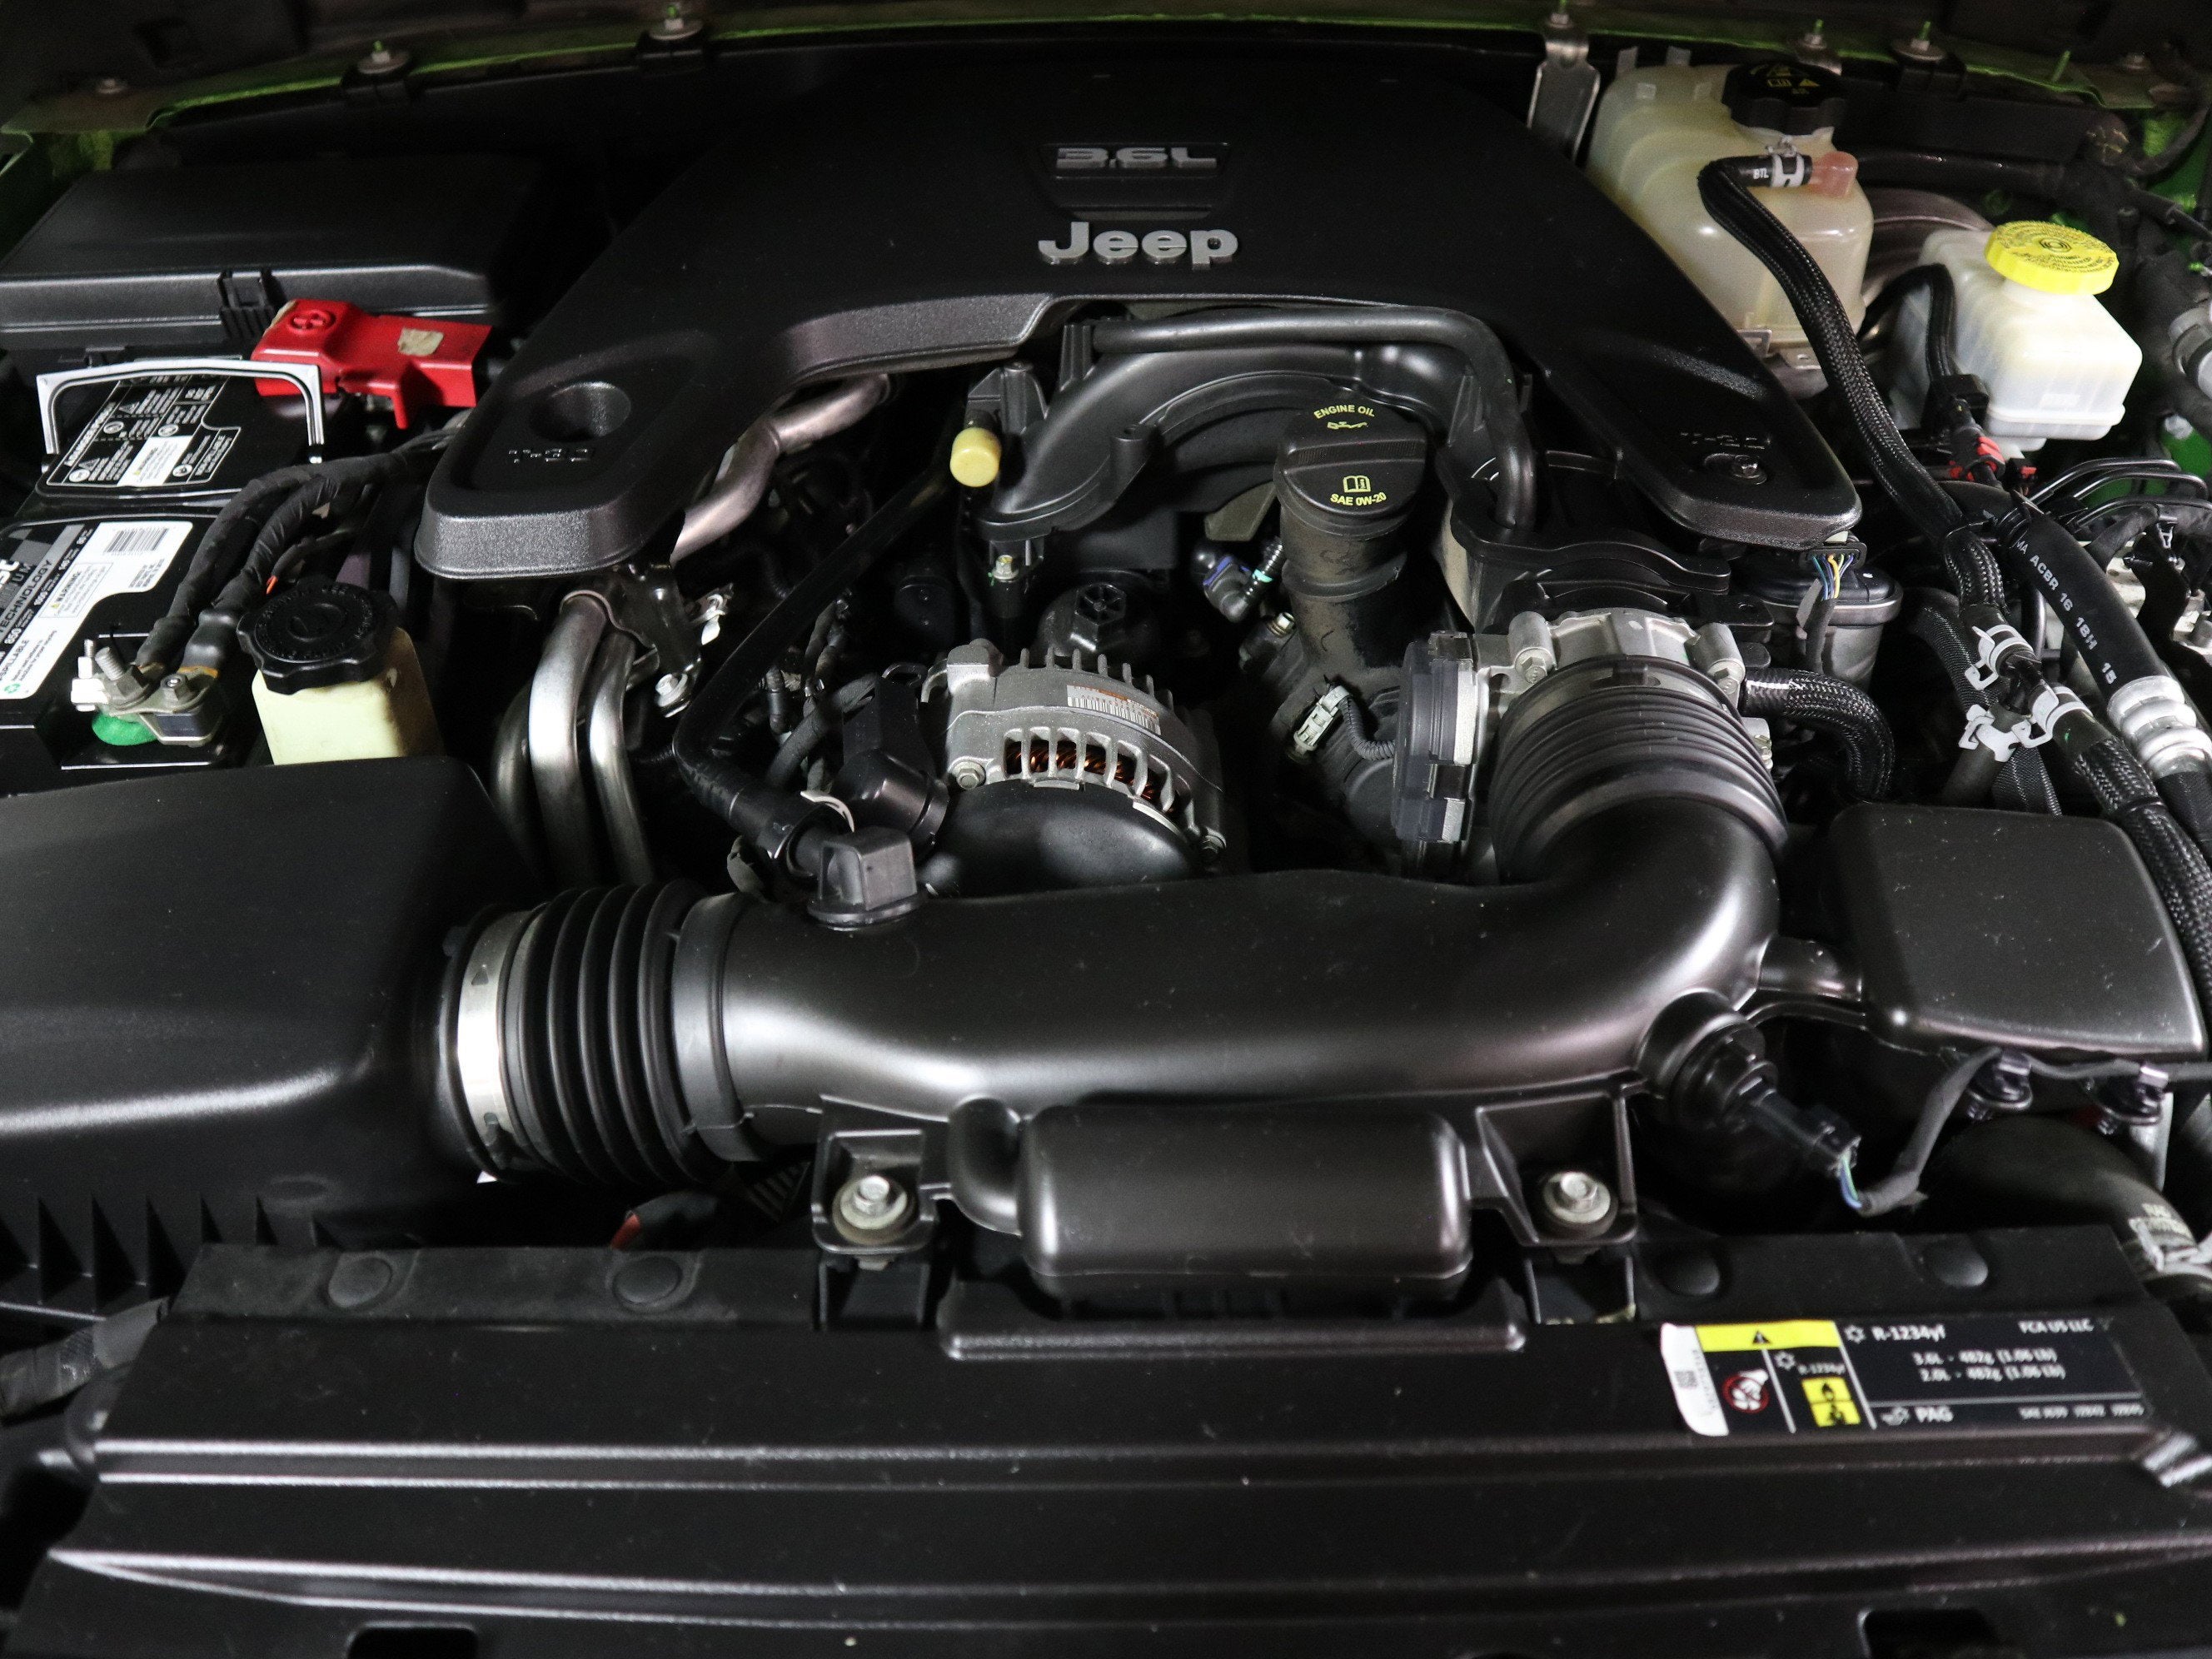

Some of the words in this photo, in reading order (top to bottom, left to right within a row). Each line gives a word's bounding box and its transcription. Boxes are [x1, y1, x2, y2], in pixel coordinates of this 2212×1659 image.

[1055, 147, 1218, 167] 3.6L
[1752, 167, 1770, 180] BTL
[1038, 221, 1238, 271] Jeep
[1313, 405, 1355, 419] ENGINE
[1358, 406, 1375, 417] OIL
[1330, 493, 1354, 506] SAE
[1355, 491, 1387, 506] 0W-20
[2030, 555, 2060, 590] ACBR
[2060, 592, 2074, 612] 16
[2101, 662, 2119, 685] 15
[1871, 1323, 1945, 1343] R-1234yf
